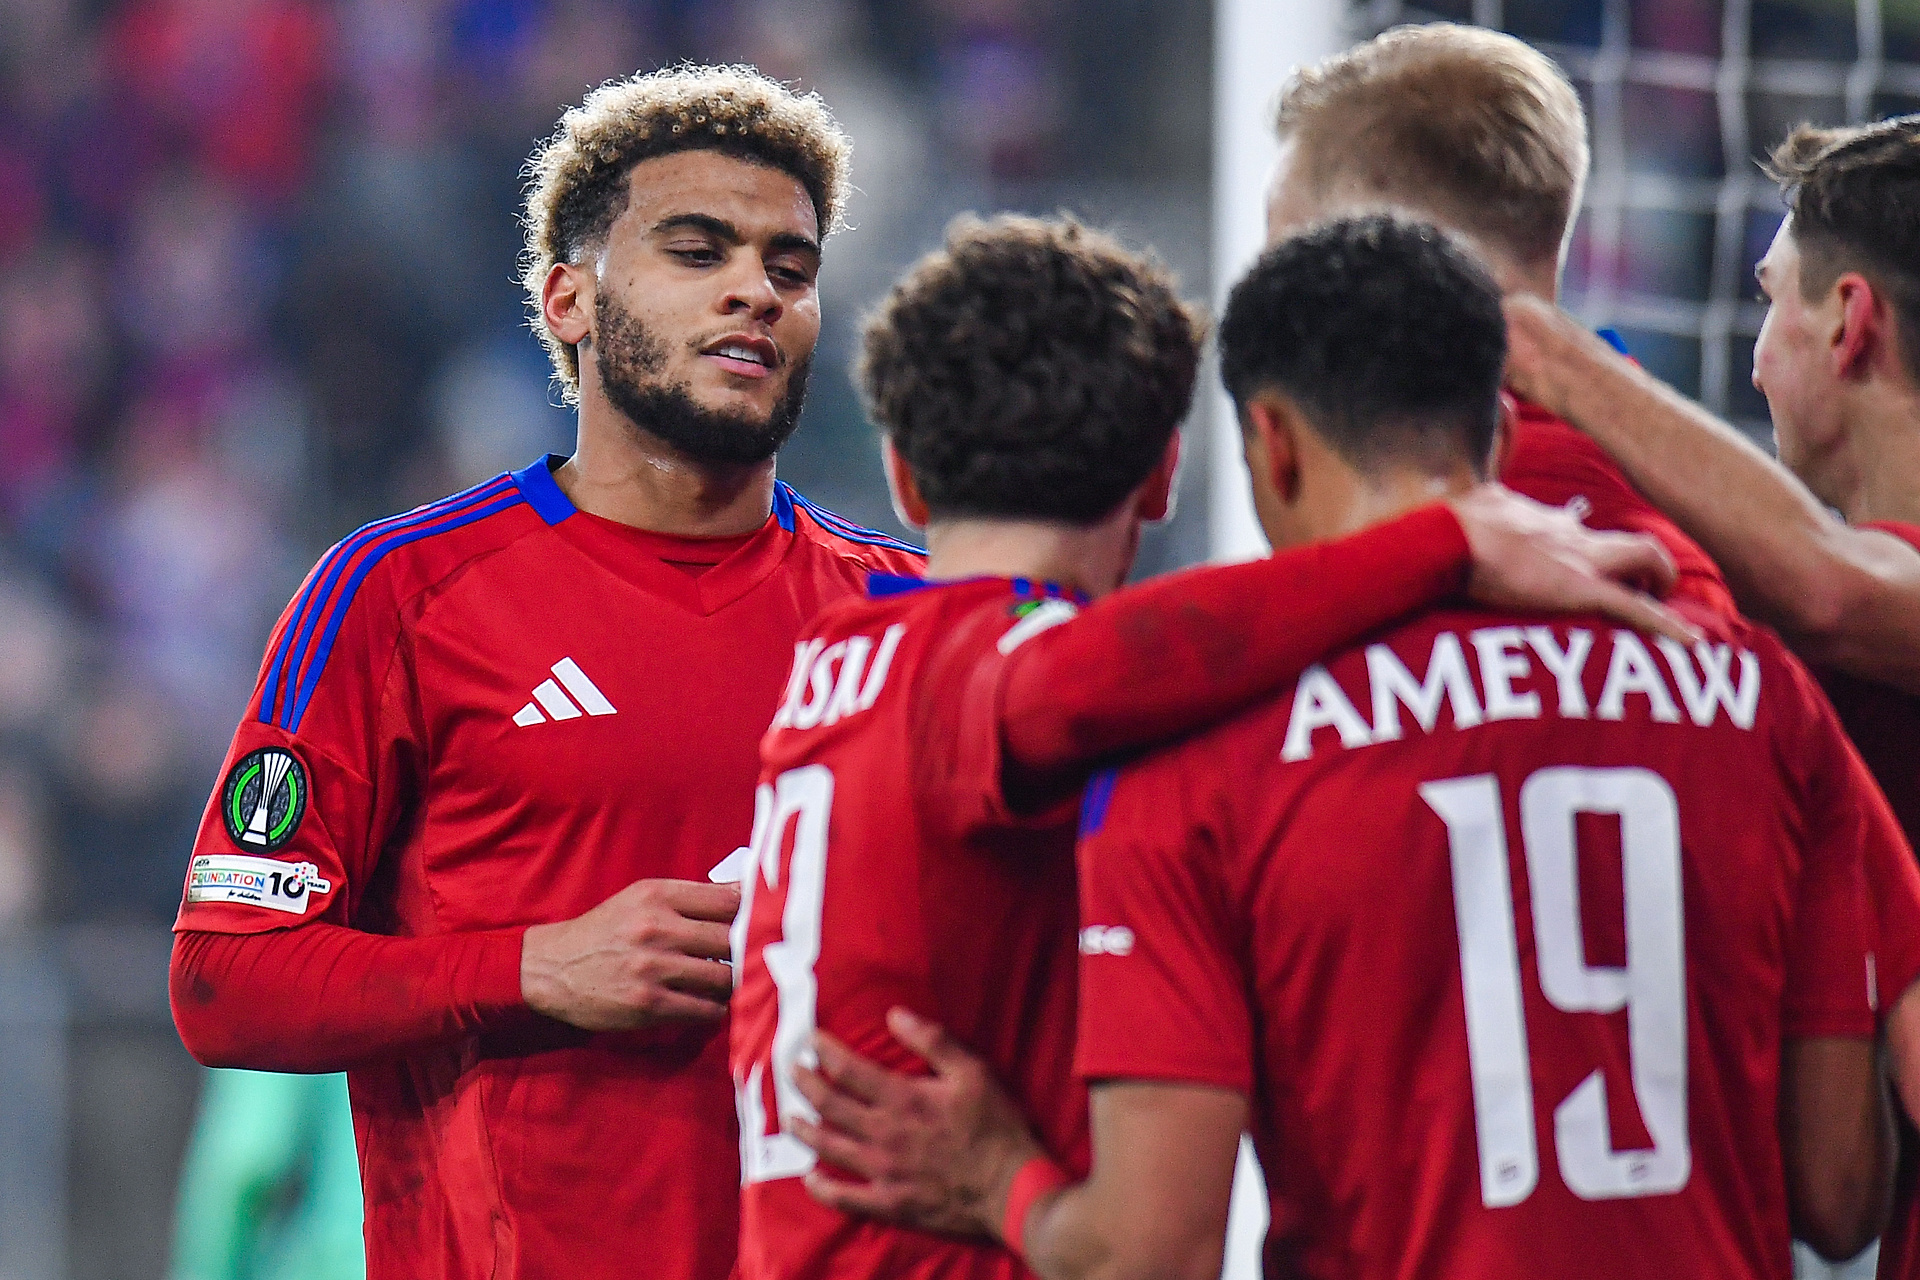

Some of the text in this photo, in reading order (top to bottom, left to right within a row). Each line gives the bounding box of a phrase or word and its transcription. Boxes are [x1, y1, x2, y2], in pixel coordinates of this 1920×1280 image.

[1281, 625, 1761, 763] AMEYAW
[191, 871, 265, 888] FOUNDATION
[269, 872, 305, 898] 10
[1418, 764, 1692, 1208] 19
